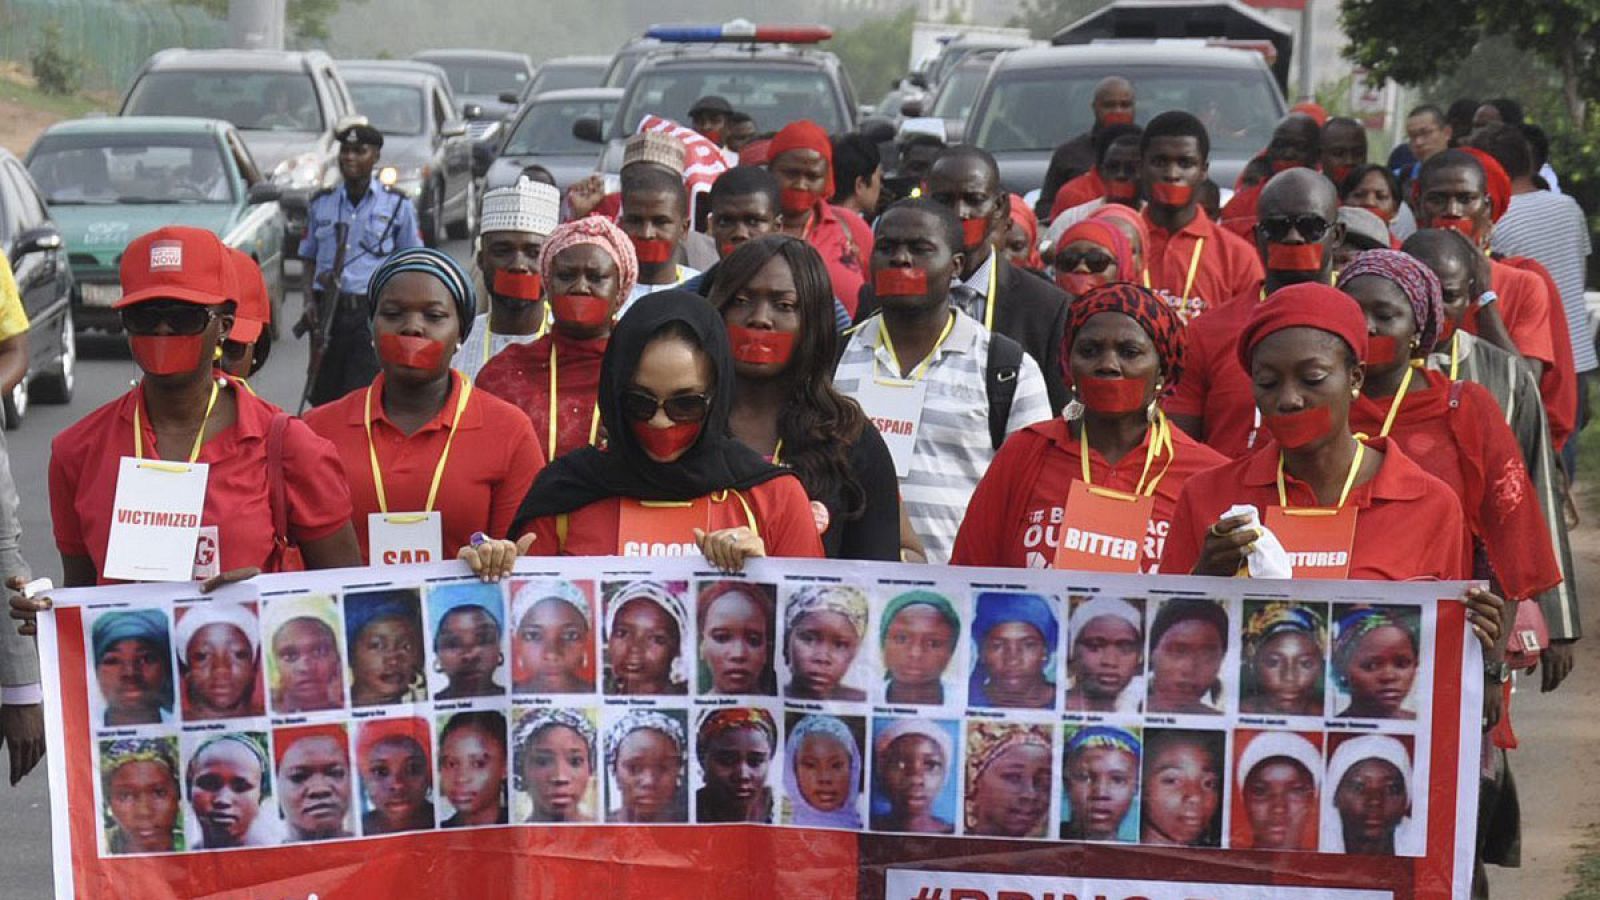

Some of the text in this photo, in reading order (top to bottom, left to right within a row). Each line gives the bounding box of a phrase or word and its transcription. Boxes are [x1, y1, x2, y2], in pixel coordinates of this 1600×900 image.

[152, 256, 180, 265] NOW
[871, 417, 913, 435] SPAIR
[118, 509, 197, 528] VICTIMIZED
[1051, 507, 1064, 523] B
[1024, 525, 1060, 548] OU
[1064, 527, 1138, 560] BITTER
[1286, 551, 1348, 568] RTURED
